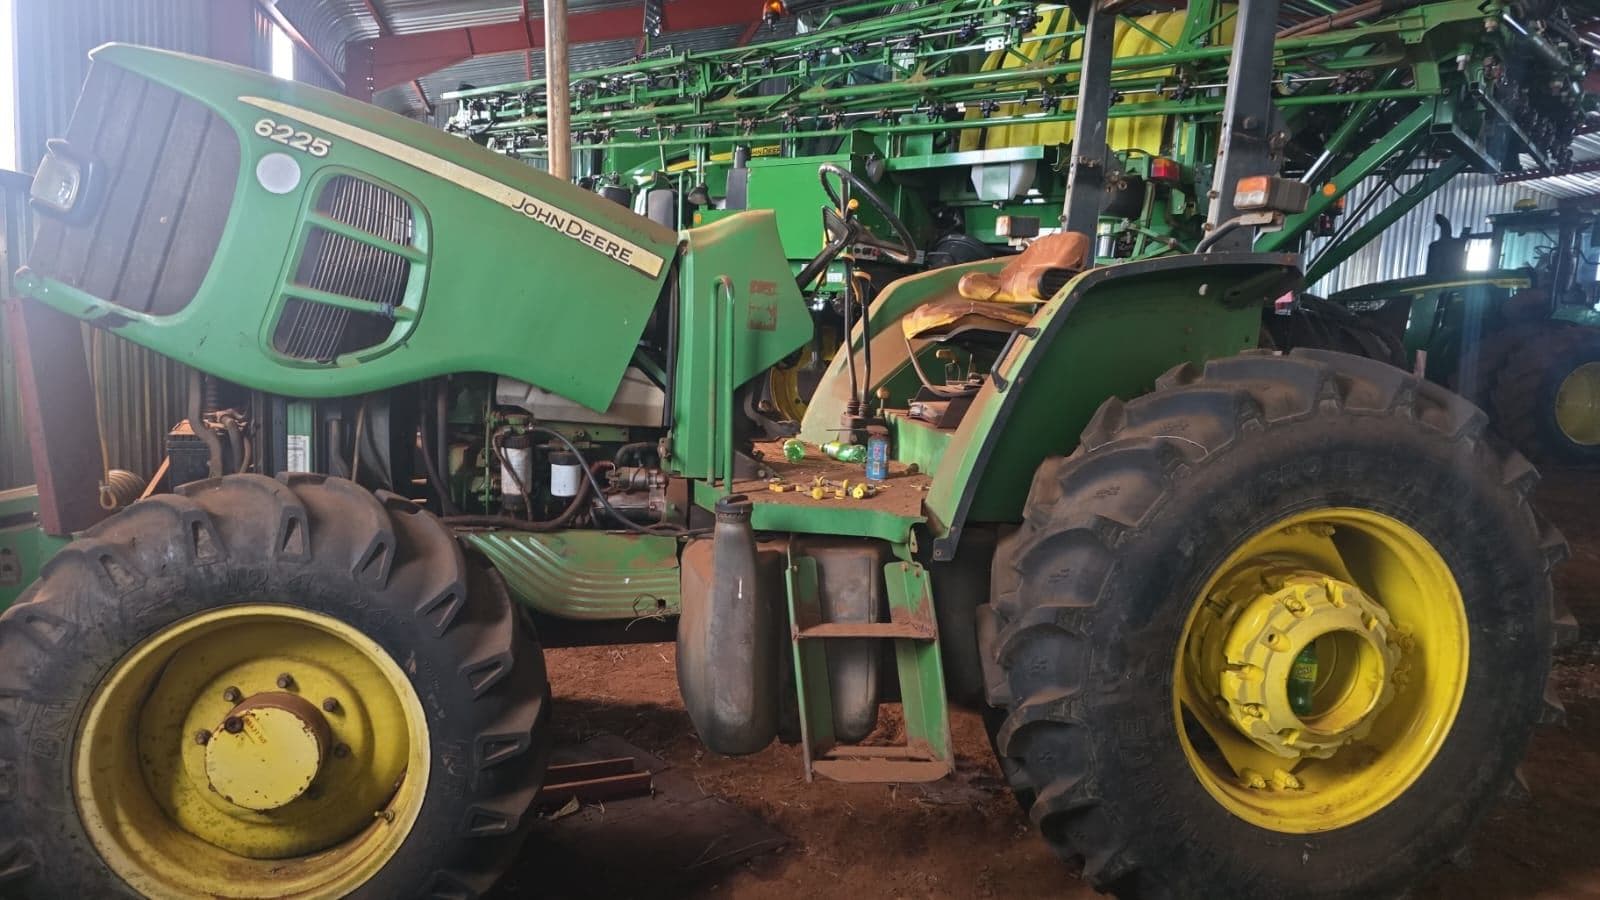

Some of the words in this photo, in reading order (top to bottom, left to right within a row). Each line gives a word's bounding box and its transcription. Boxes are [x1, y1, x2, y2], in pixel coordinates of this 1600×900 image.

[255, 118, 333, 157] 6225
[512, 198, 565, 230] JOHN
[566, 220, 633, 262] DEERE
